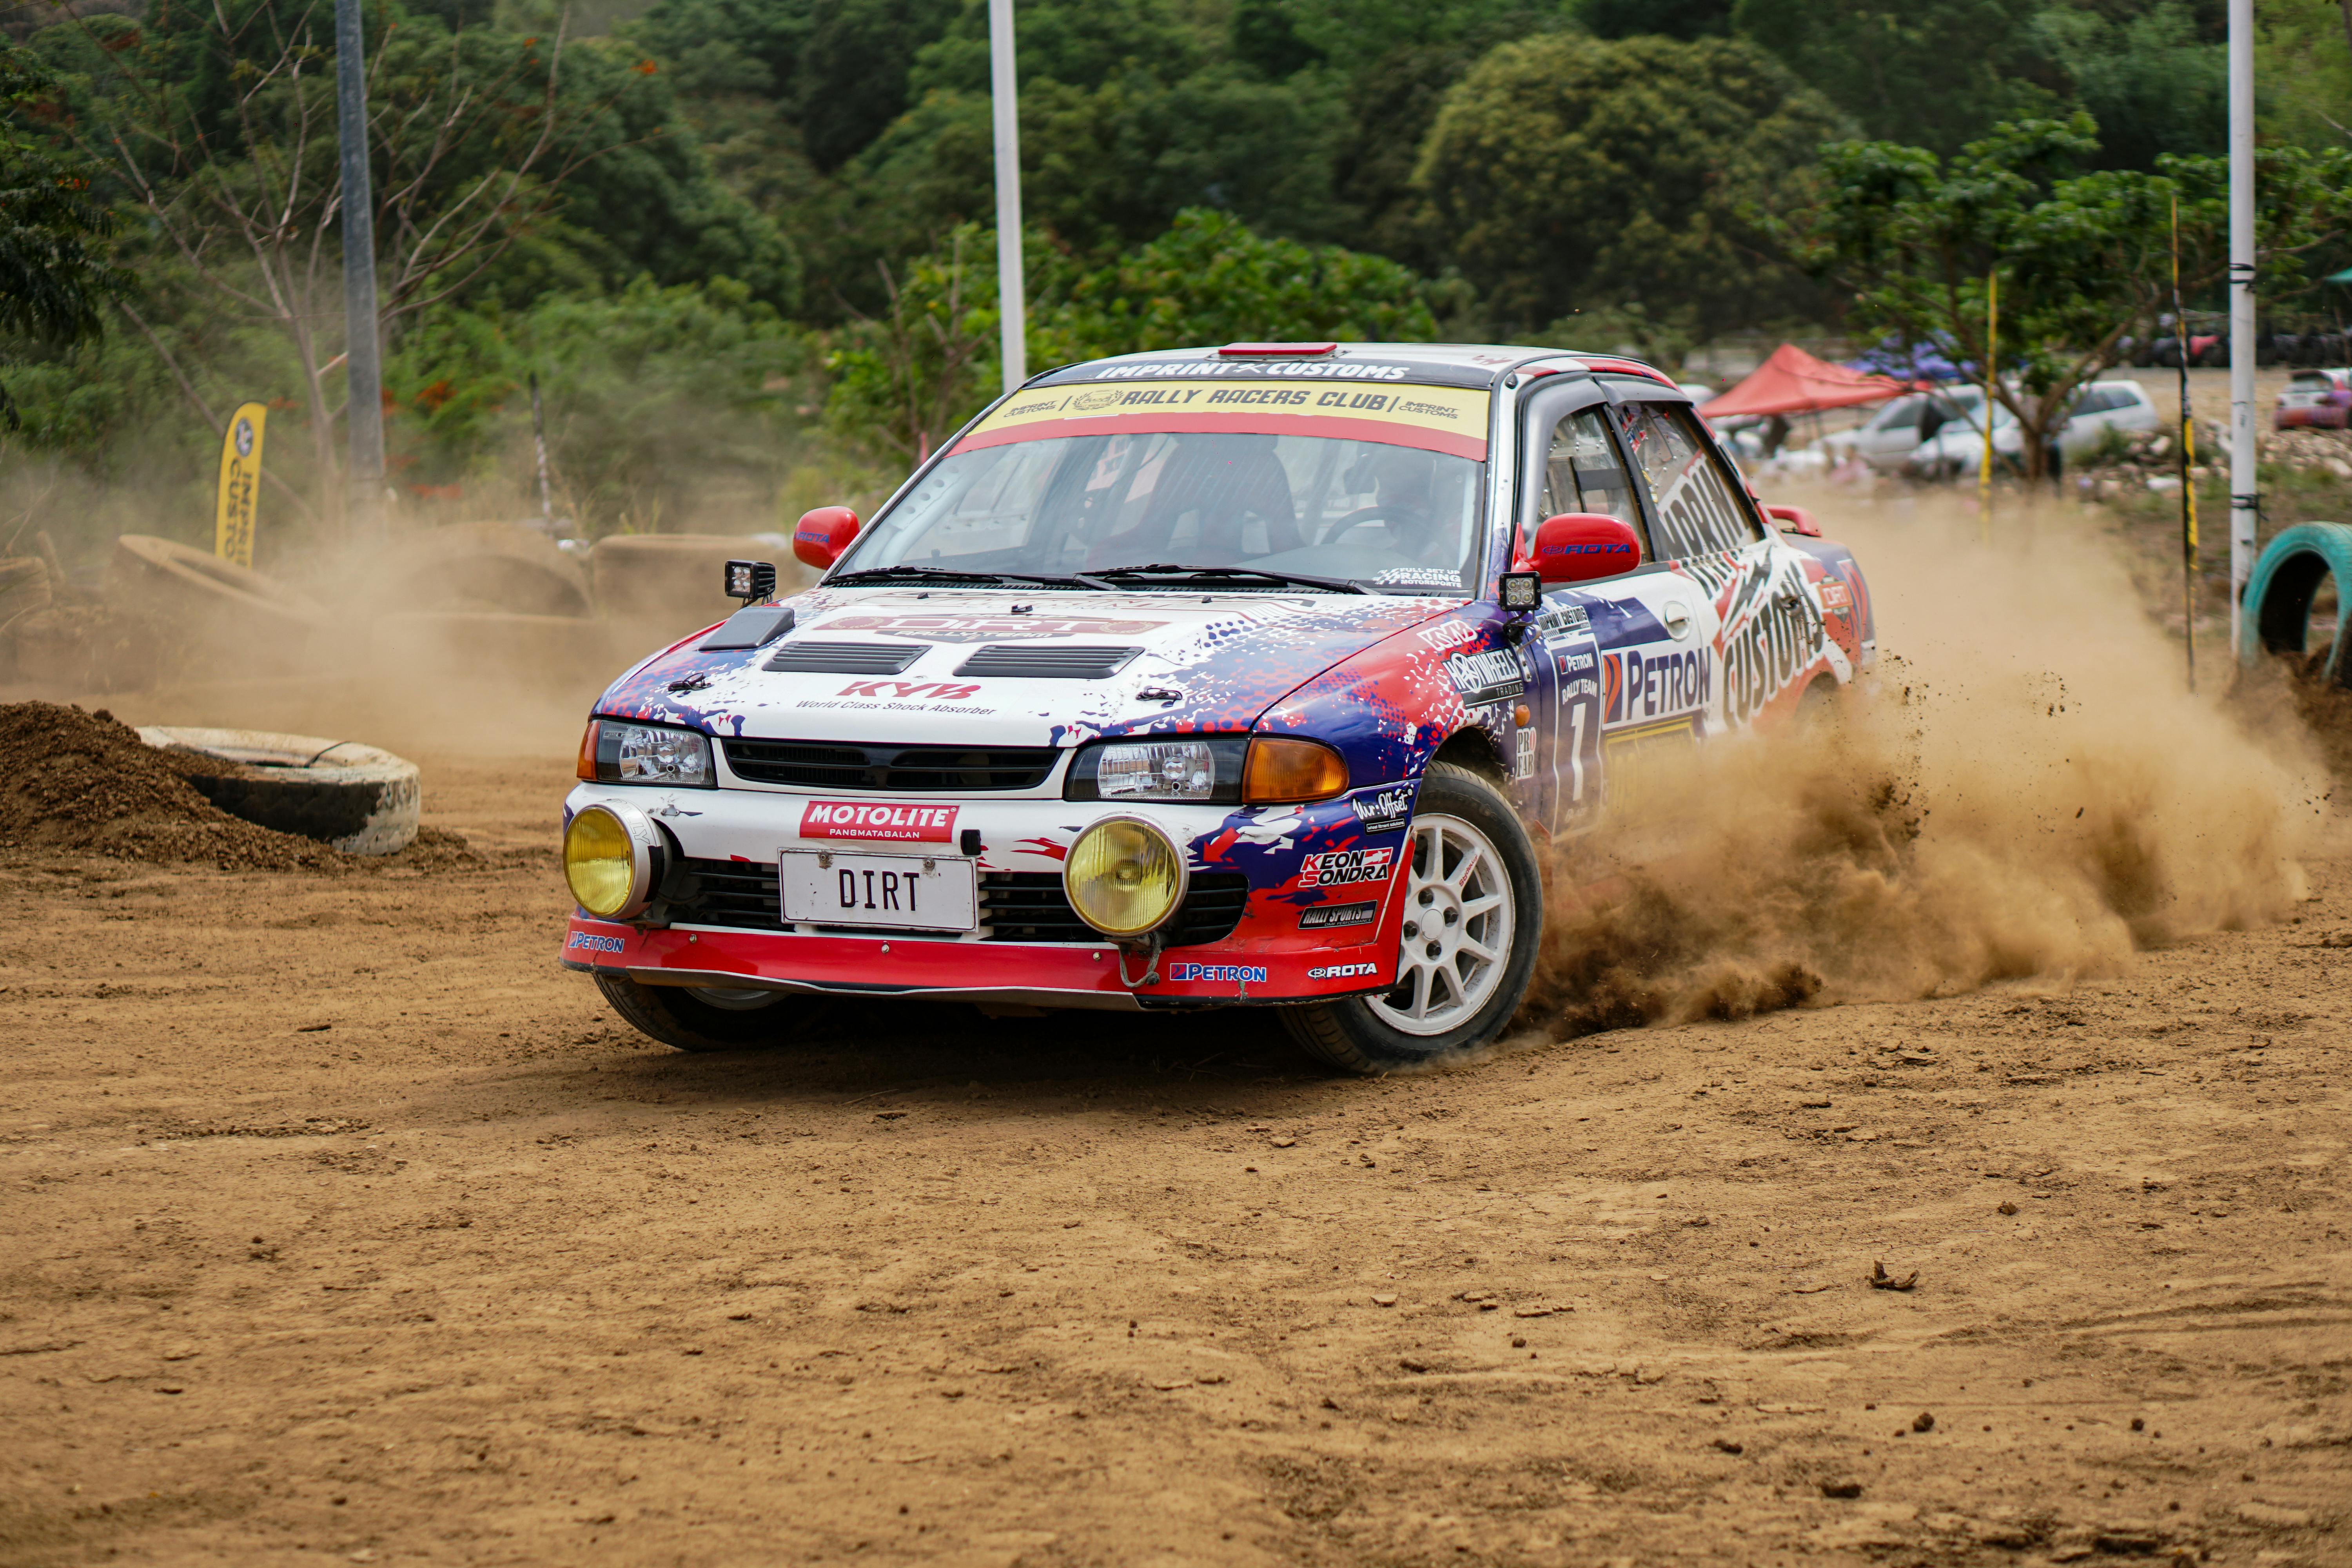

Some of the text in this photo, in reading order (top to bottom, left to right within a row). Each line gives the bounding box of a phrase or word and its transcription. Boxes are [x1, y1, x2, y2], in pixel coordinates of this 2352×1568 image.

[1096, 363, 1410, 379] IMPRINT CUSTOMS
[1011, 400, 1059, 412] IMPRINT
[1120, 390, 1388, 410] RALLY RACERS CLUB
[1405, 401, 1461, 413] IMPRINT
[1004, 405, 1056, 417] CUSTOMS
[1399, 406, 1458, 418] CUSTOMS
[797, 532, 829, 543] ROTA
[1564, 544, 1630, 554] ROTA
[1400, 572, 1461, 583] RACING
[1401, 579, 1462, 588] MOTORSPORTS
[1566, 652, 1593, 672] PETRON
[835, 681, 981, 699] KYB
[1496, 683, 1524, 697] TRADING
[1562, 678, 1597, 705] RALLY TEAM
[1627, 646, 1711, 720] PETRON
[795, 700, 998, 715] World Class Shock Absorber
[1517, 730, 1536, 753] PRO
[1571, 702, 1586, 801] 1
[1517, 754, 1534, 777] FAB
[808, 804, 949, 827] MOTOLITE
[829, 828, 920, 838] PANGMATAGALAN
[1301, 850, 1365, 872] KEON
[1298, 864, 1388, 887] SONDRA
[838, 868, 920, 911] DIRT
[1302, 905, 1364, 924] RALLY SPORTS
[575, 931, 624, 953] PETRON
[1189, 963, 1267, 982] PETRON
[1327, 963, 1378, 978] ROTA
